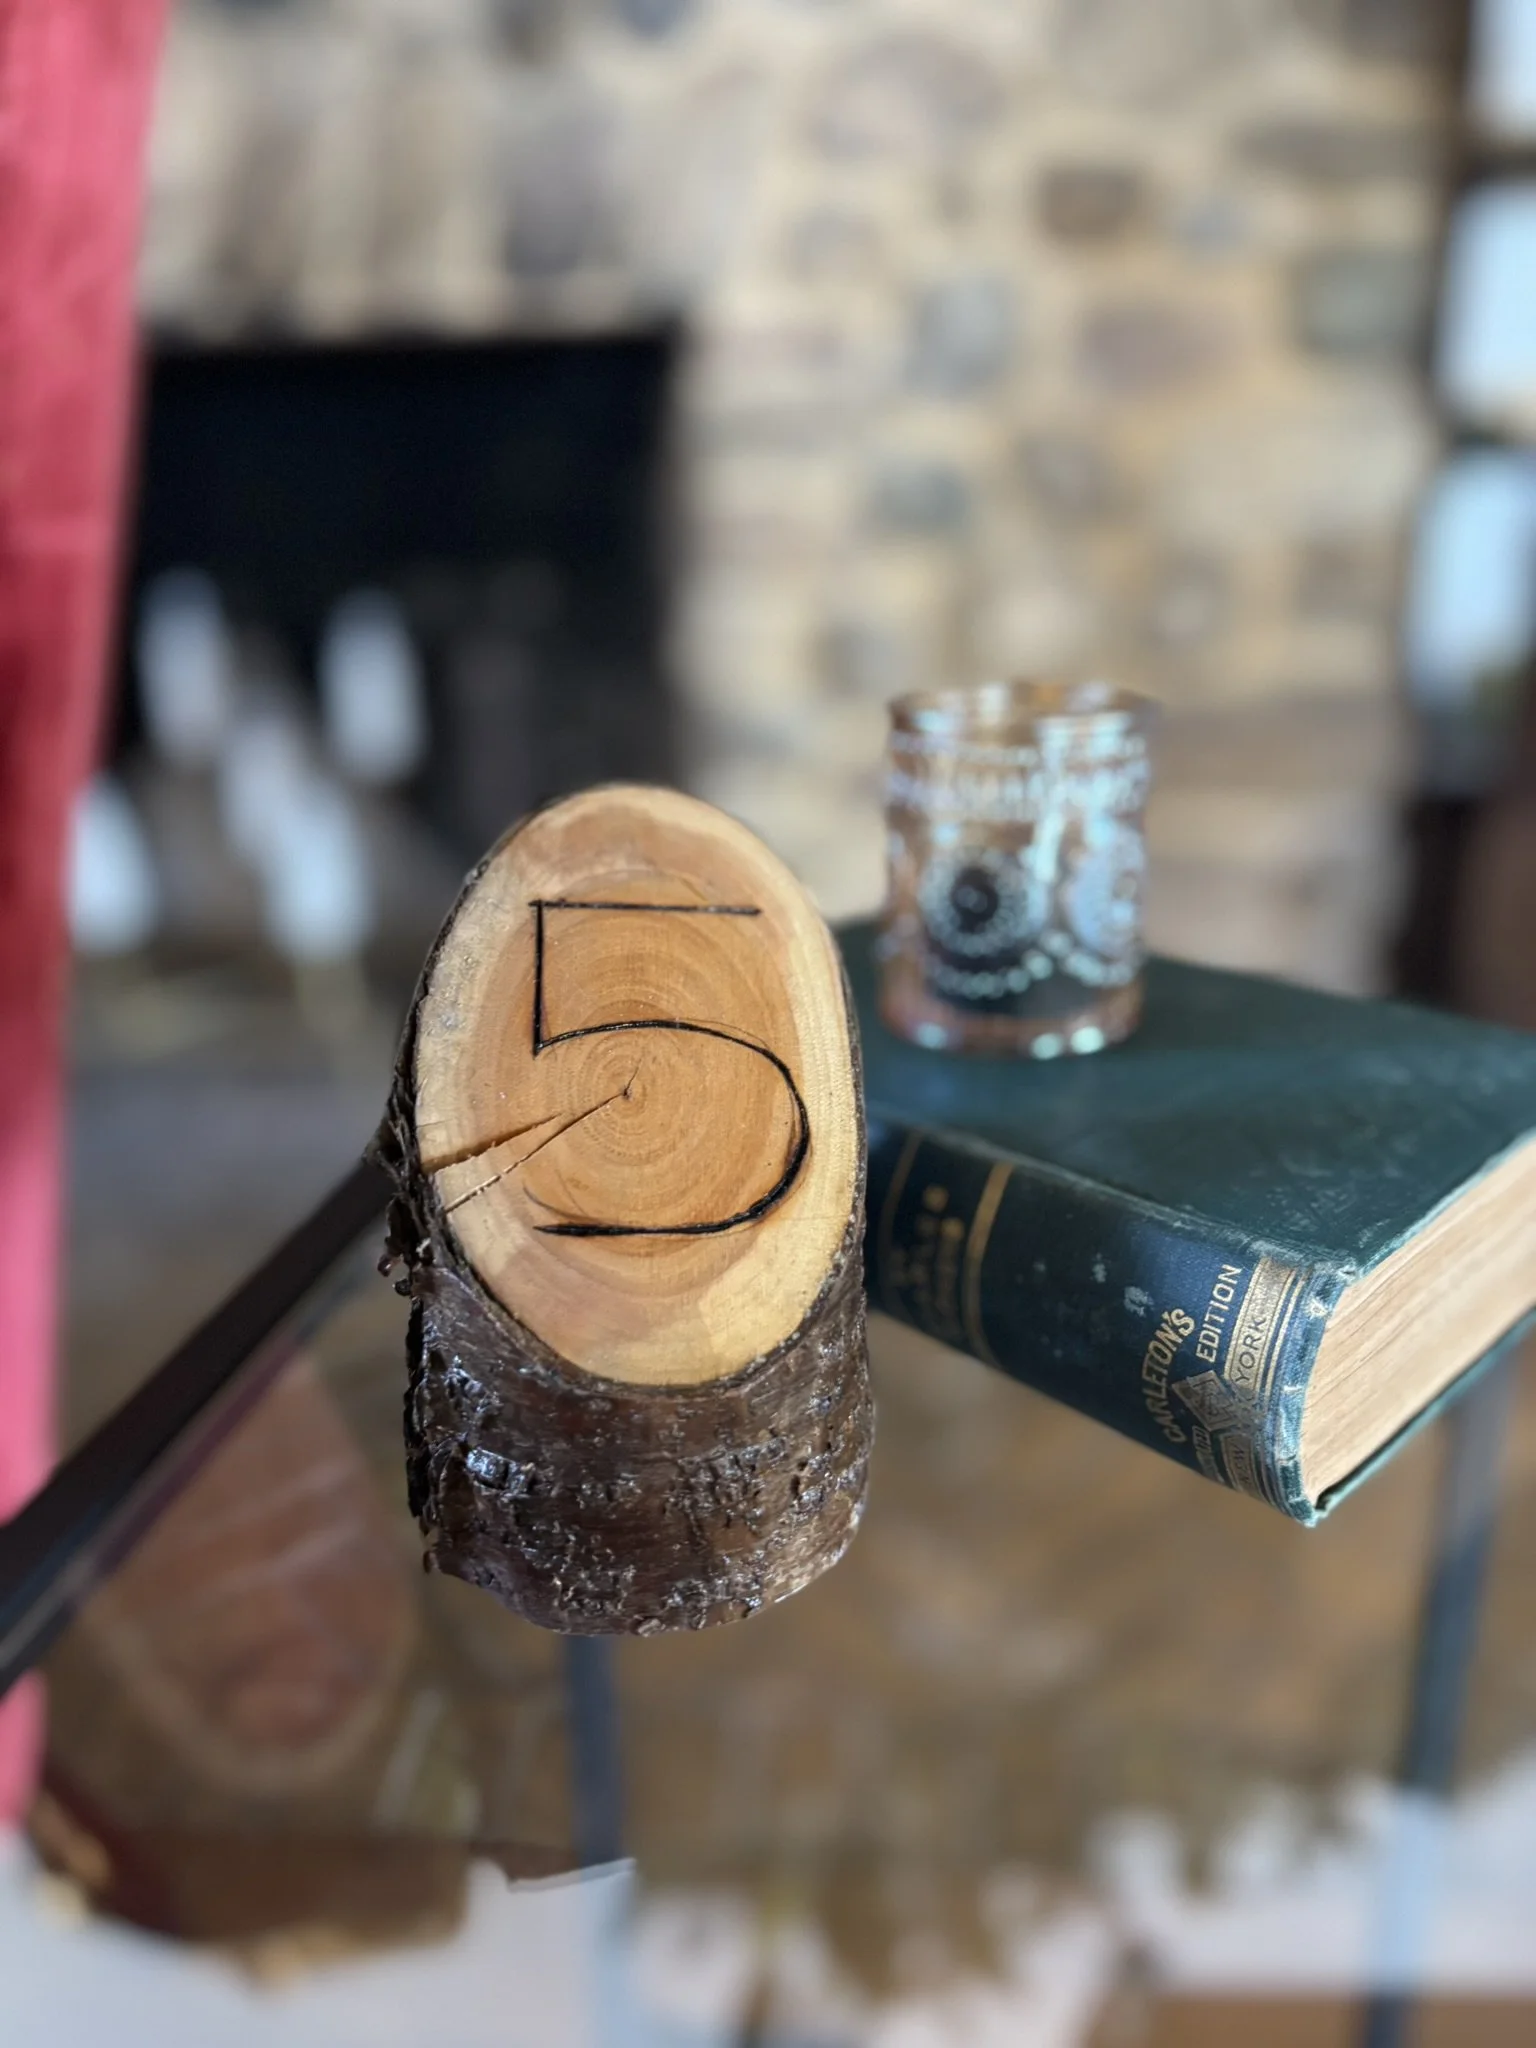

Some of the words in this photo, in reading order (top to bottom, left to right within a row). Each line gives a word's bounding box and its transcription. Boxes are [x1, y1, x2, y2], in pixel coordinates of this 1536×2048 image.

[527, 898, 810, 1238] 5
[1196, 1264, 1243, 1364] EDITION
[1235, 1315, 1267, 1384] YORK
[1142, 1307, 1196, 1443] CARLETON'S
